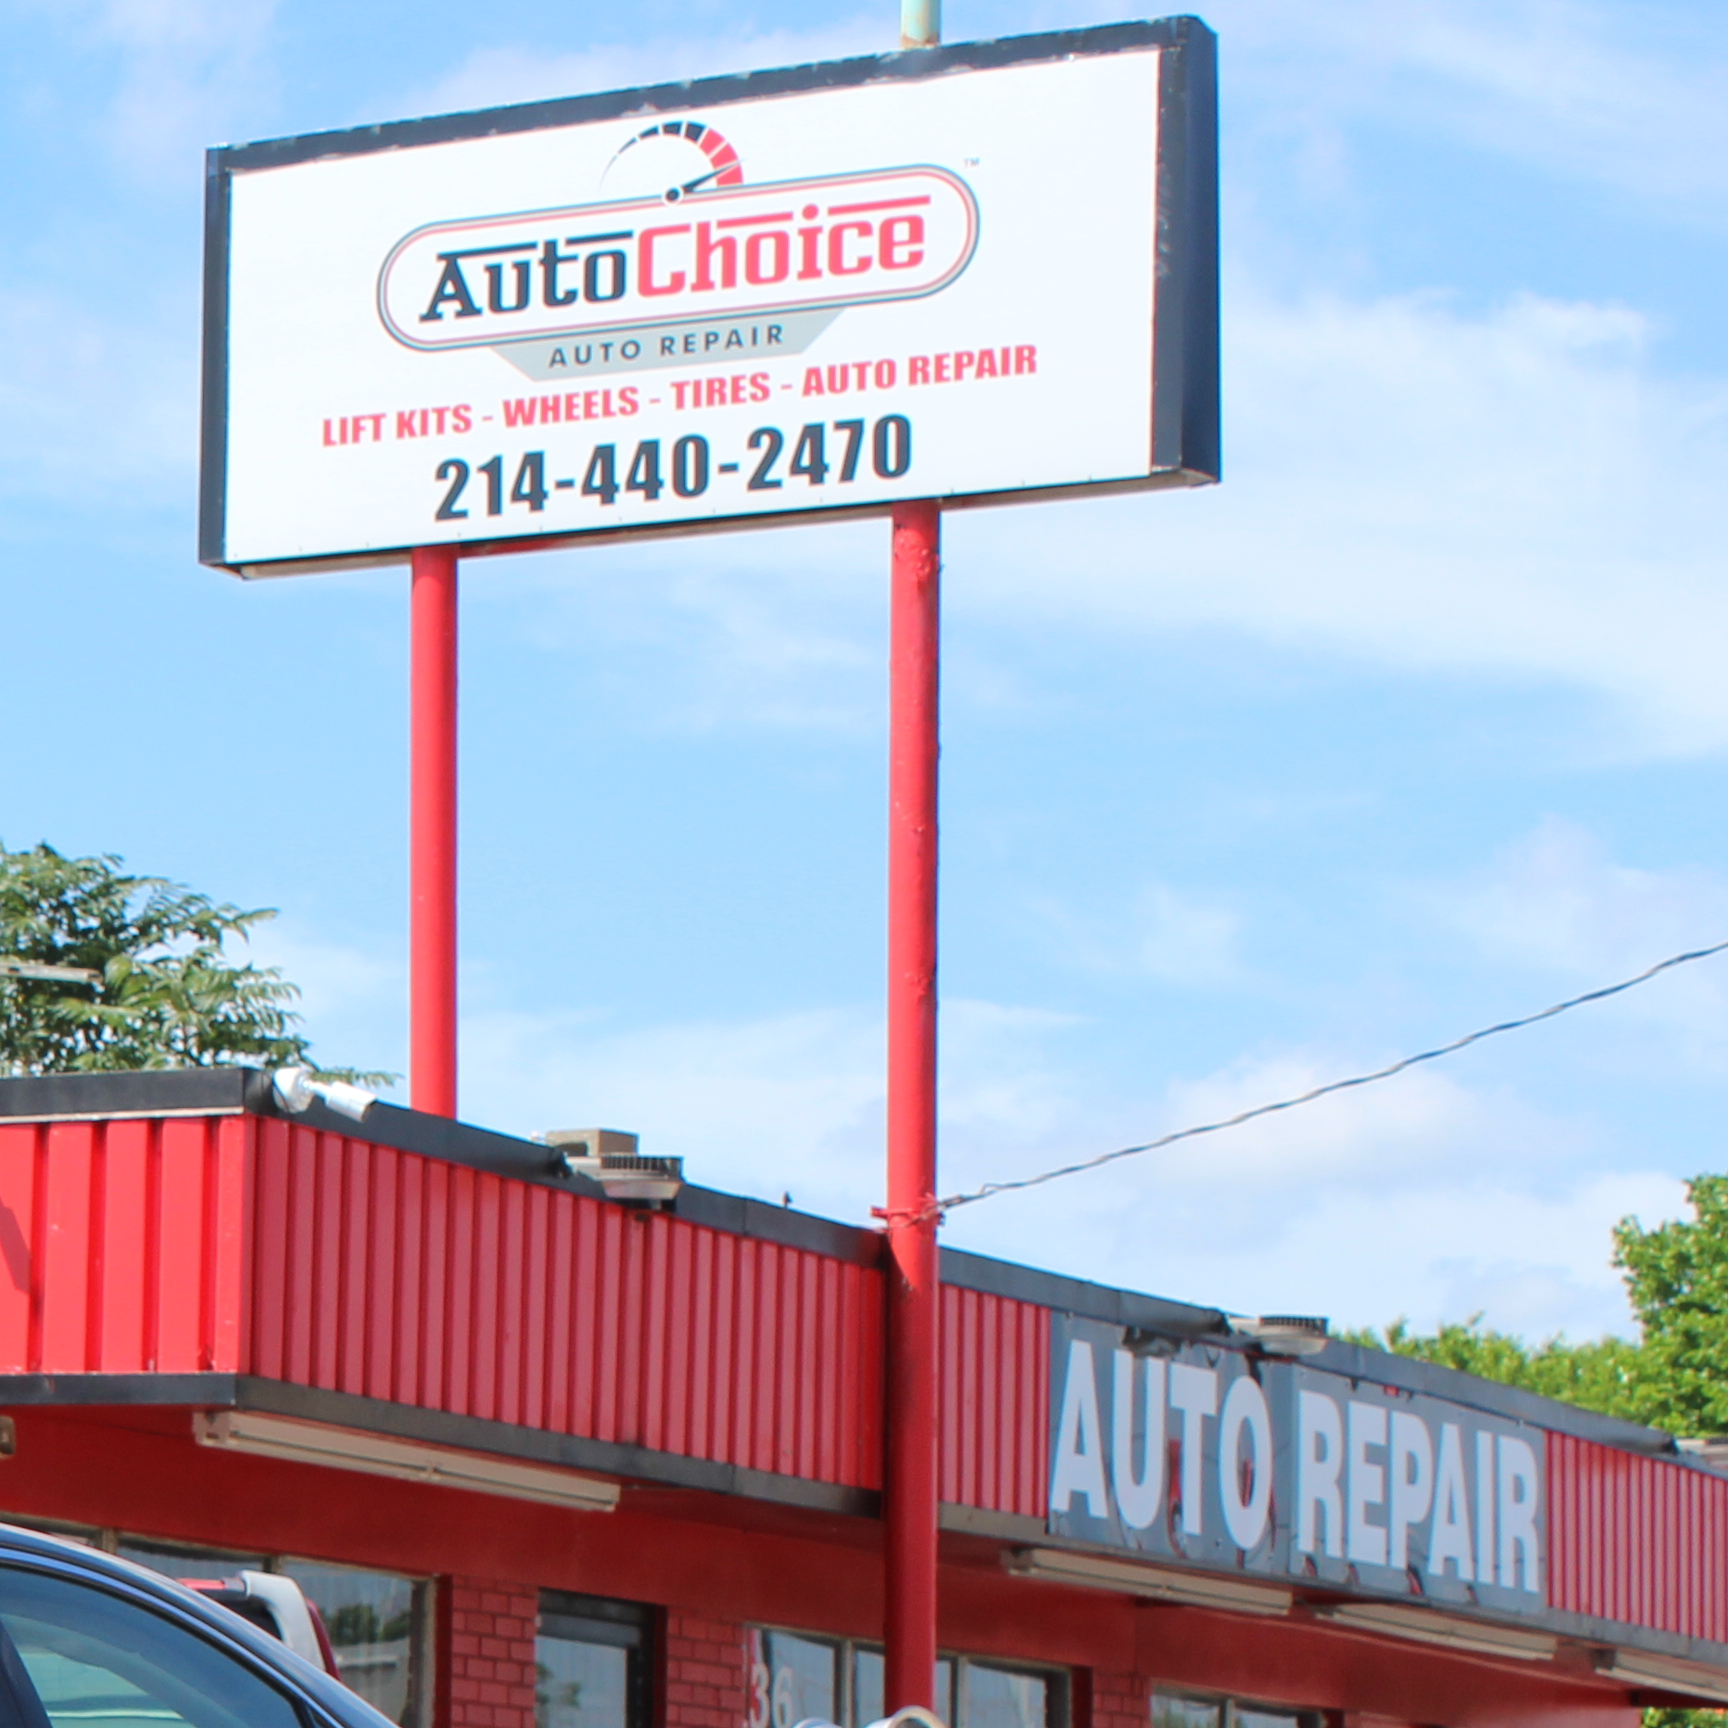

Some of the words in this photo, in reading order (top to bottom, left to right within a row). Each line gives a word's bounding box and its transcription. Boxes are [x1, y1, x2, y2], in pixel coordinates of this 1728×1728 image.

[419, 195, 931, 323] AutoChoice
[322, 412, 387, 447] LIFT
[396, 403, 473, 440] KITS
[502, 386, 640, 428] WHEELS
[670, 372, 771, 411] TIRES
[802, 358, 895, 397] AUTO
[908, 344, 1038, 386] REPAIR
[548, 340, 642, 369] AUTO
[659, 324, 784, 357] REPAIR
[434, 412, 912, 523] 214-440-2470
[1049, 1339, 1274, 1554] AUTO
[1297, 1389, 1540, 1594] REPAIR
